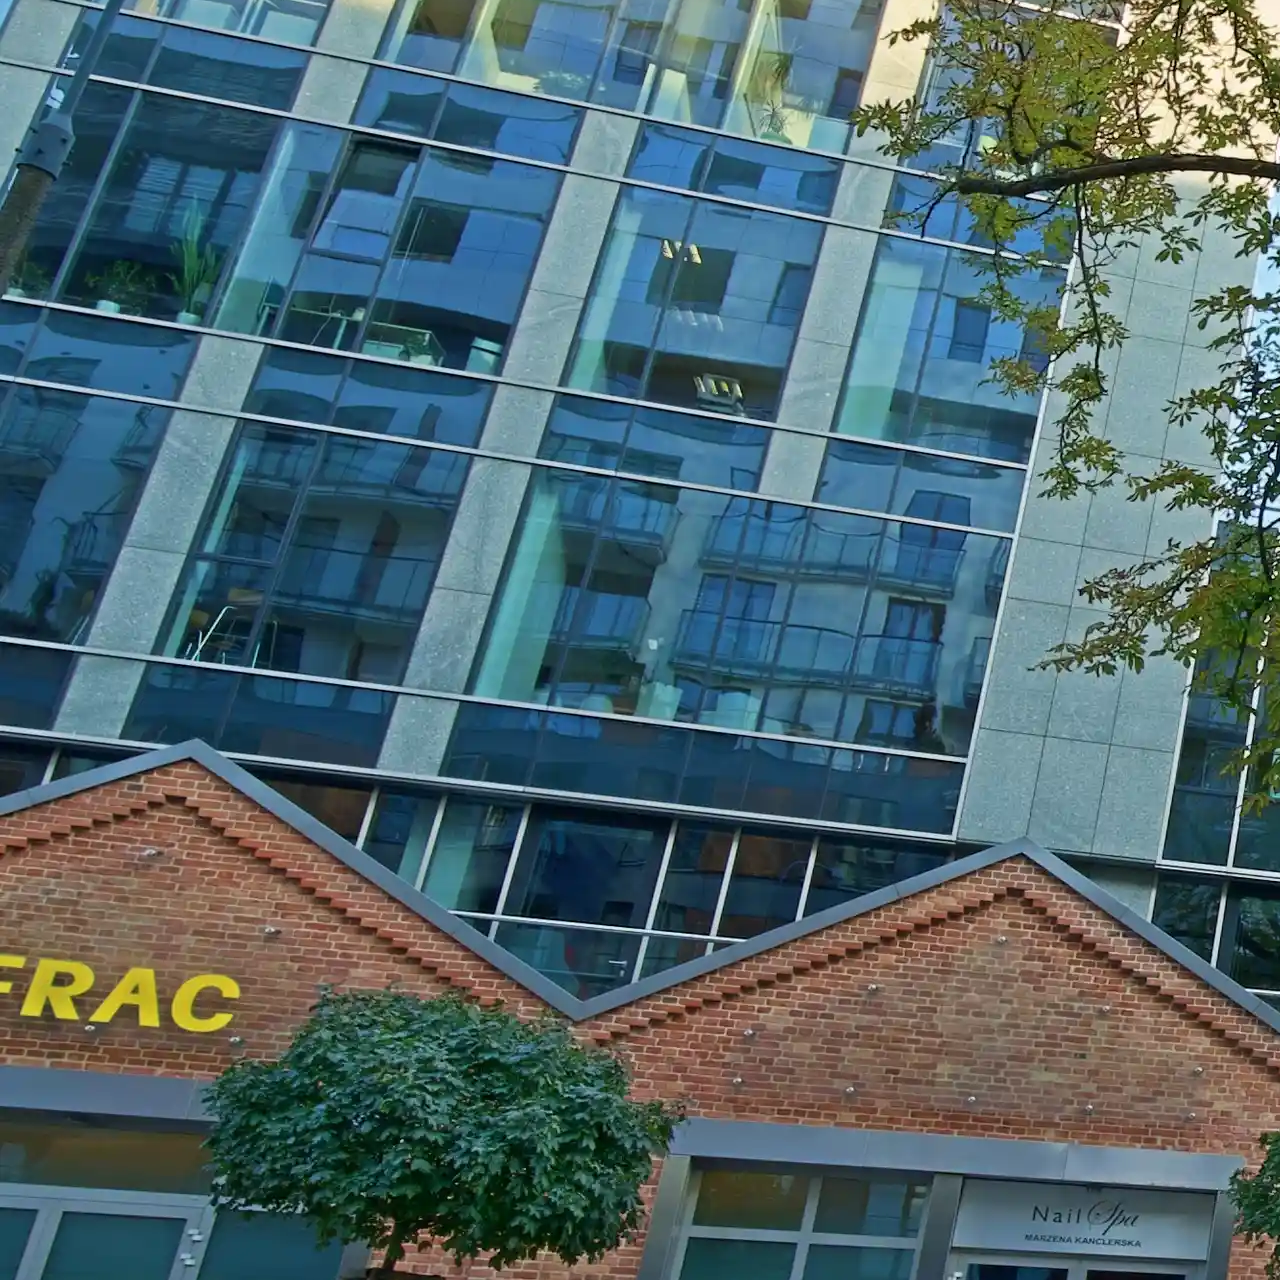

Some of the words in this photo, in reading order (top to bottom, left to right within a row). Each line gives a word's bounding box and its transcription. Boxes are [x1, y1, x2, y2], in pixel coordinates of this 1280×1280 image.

[1032, 1205, 1081, 1224] Nail
[1087, 1200, 1140, 1236] Spa
[1024, 1233, 1072, 1244] MARZENA
[1074, 1236, 1142, 1248] KANCLERSKA
